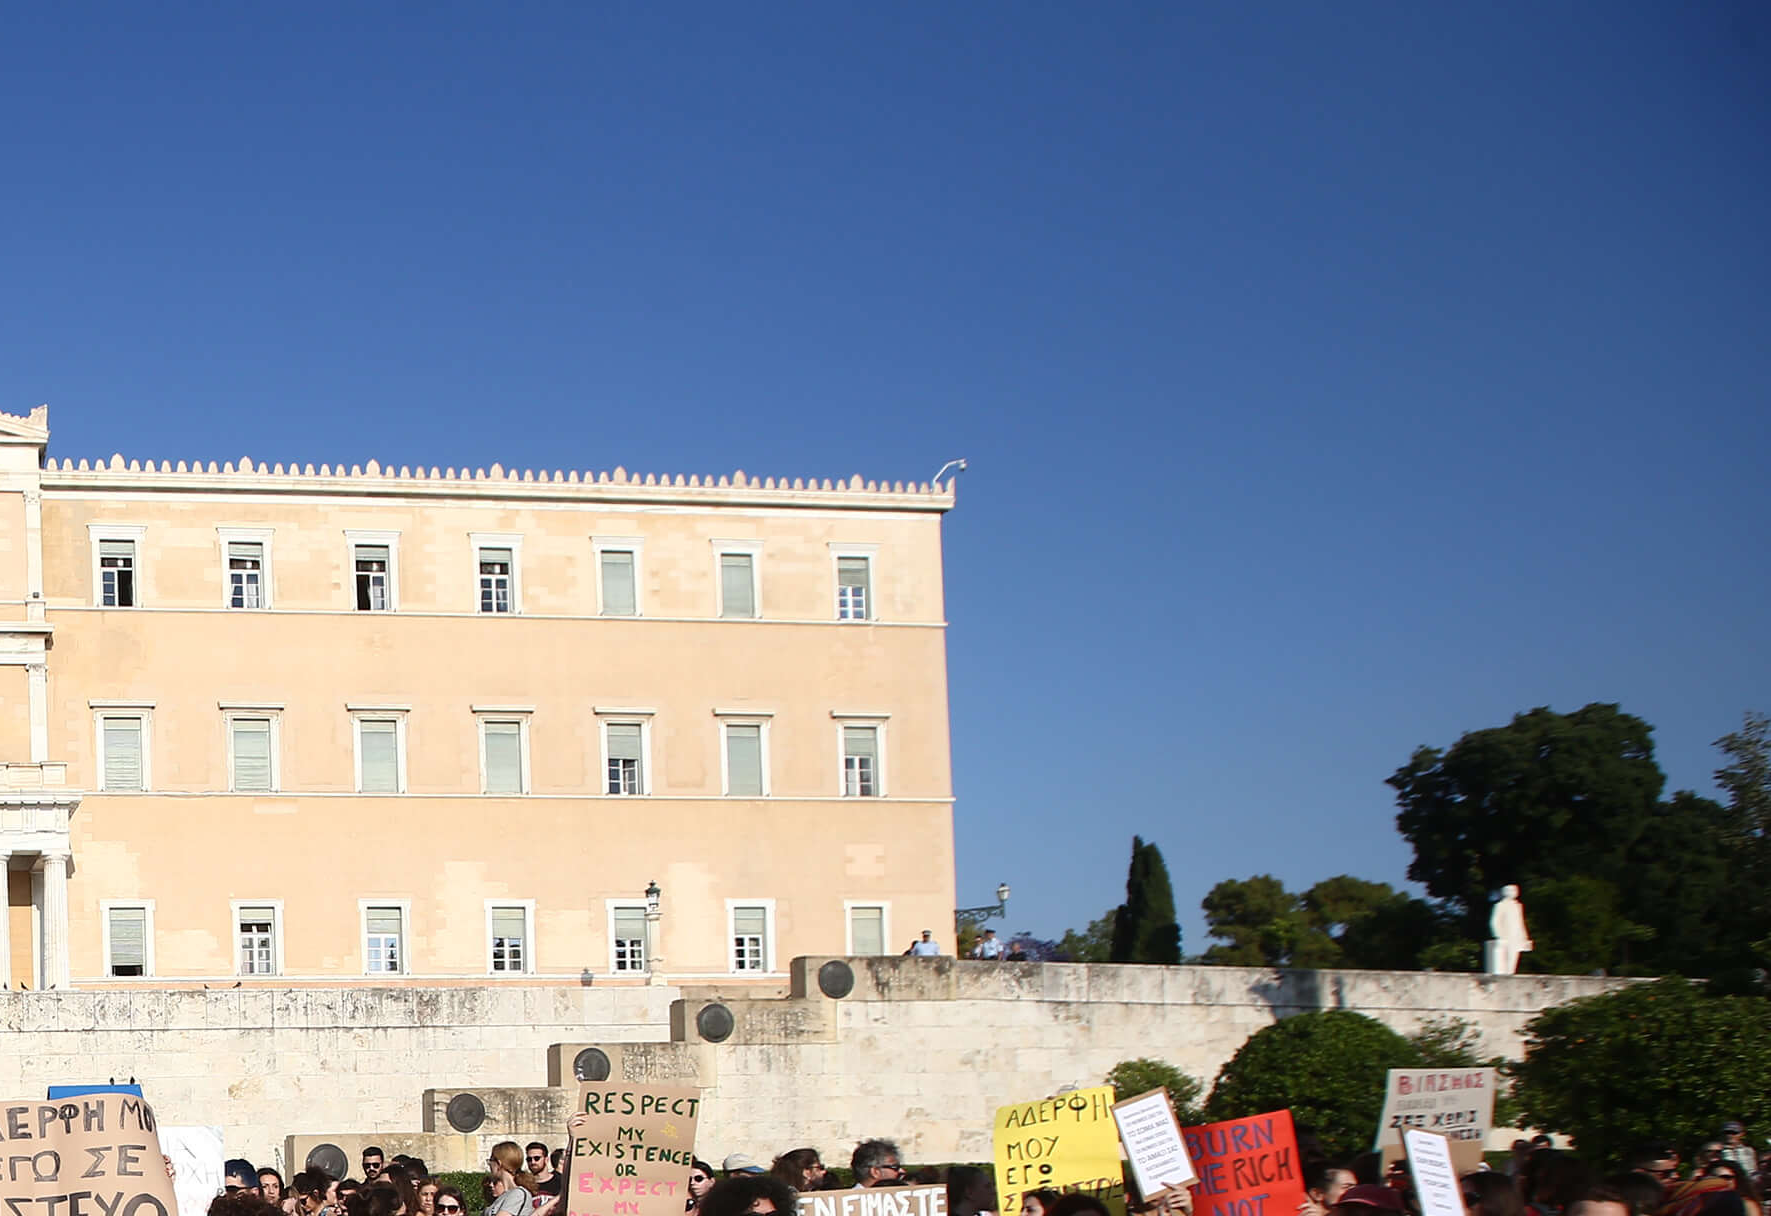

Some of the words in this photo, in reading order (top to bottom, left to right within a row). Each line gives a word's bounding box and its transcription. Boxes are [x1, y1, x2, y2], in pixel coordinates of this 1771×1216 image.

[585, 1091, 700, 1118] RESPECT
[1005, 1093, 1108, 1128] ΑΔΕΡΦΗ
[618, 1126, 645, 1141] MY
[1186, 1119, 1273, 1161] BURN
[575, 1138, 692, 1166] EXISTENCE
[1007, 1136, 1059, 1160] ΜΟΥ
[81, 1145, 146, 1178] ΣΕ
[615, 1163, 637, 1177] OR
[1233, 1147, 1294, 1190] RICH
[579, 1172, 678, 1196] EXPECT
[1007, 1164, 1053, 1185] ΕΓΩ
[614, 1201, 639, 1215] MY
